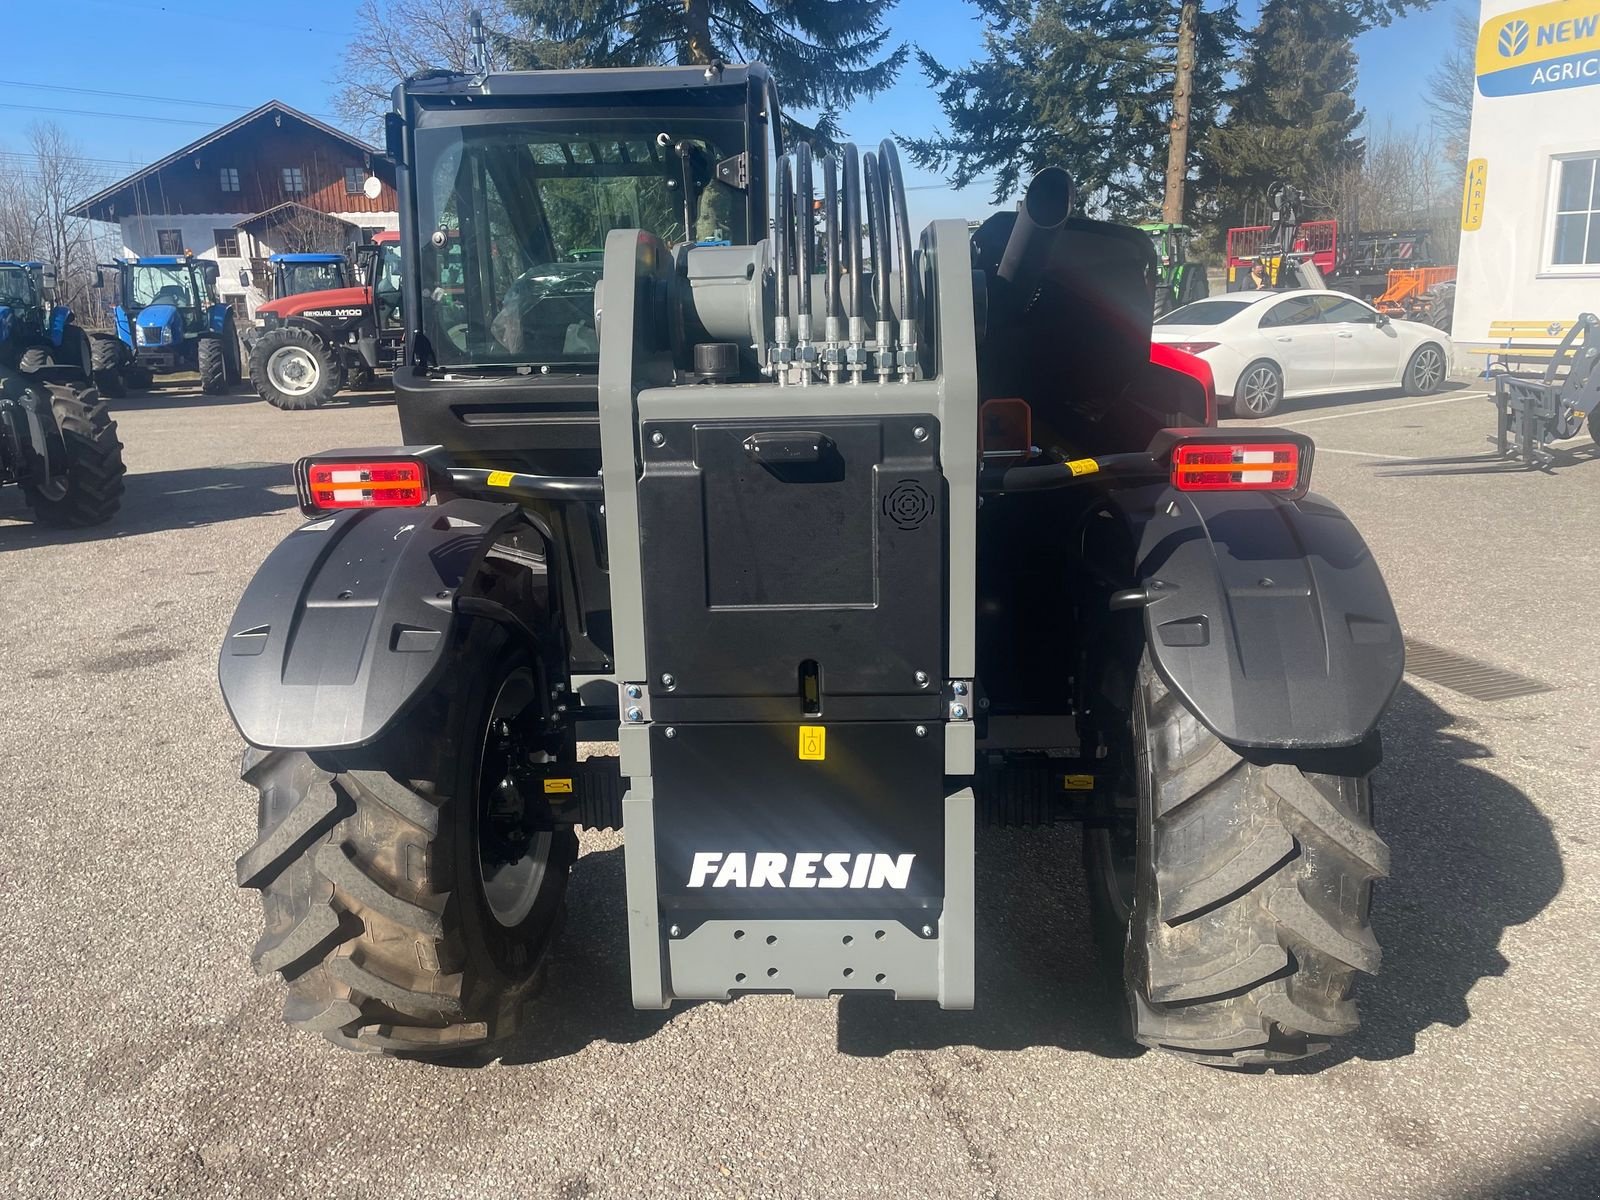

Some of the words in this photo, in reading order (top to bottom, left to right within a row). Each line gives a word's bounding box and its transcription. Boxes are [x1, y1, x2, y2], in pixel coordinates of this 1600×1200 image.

[1536, 14, 1600, 47] NEW
[1531, 58, 1600, 85] AGRIC
[1472, 165, 1484, 223] PARTS
[335, 309, 362, 317] M100
[686, 852, 917, 889] FARESIN
